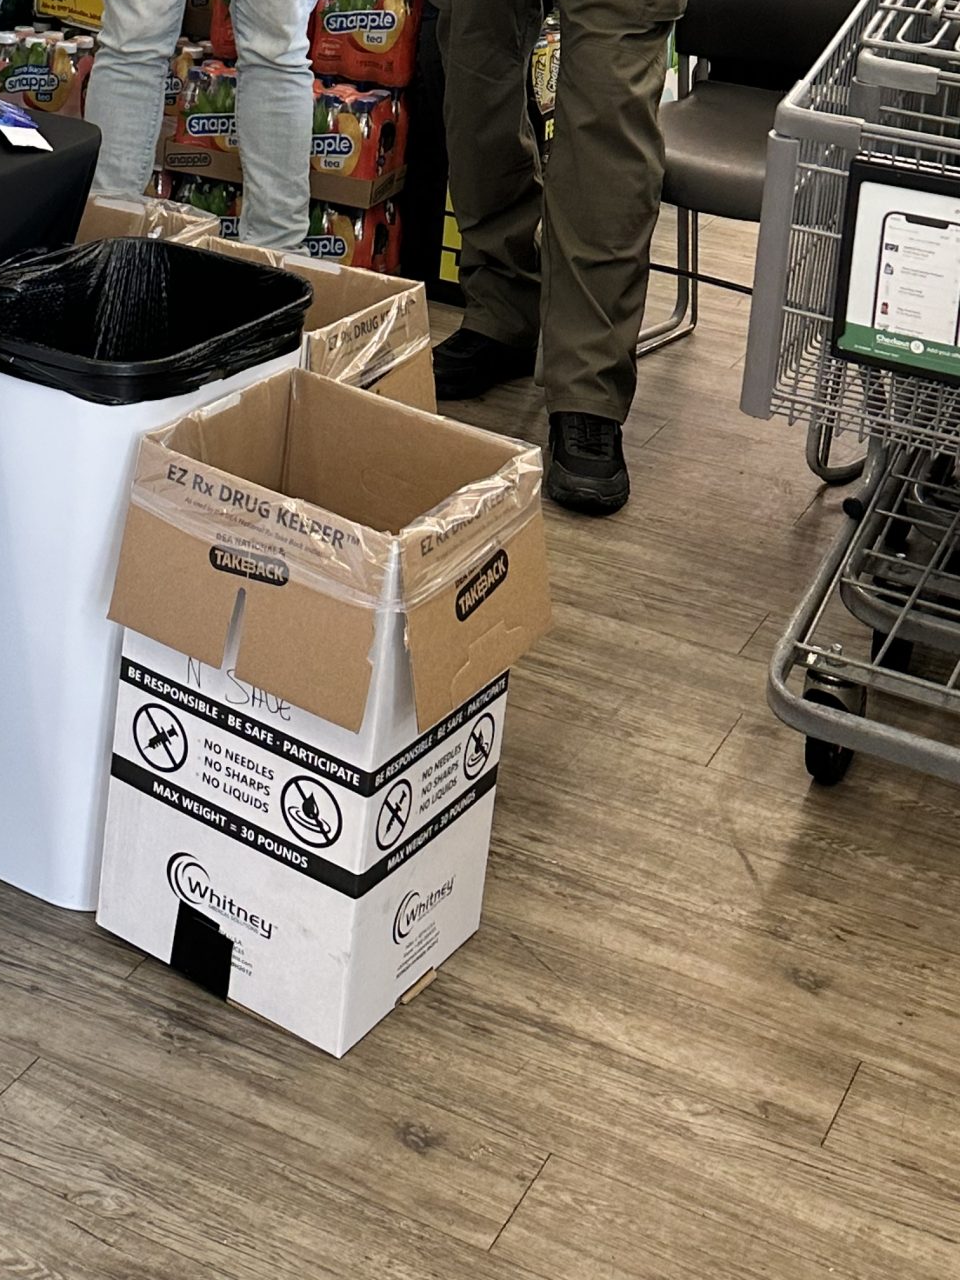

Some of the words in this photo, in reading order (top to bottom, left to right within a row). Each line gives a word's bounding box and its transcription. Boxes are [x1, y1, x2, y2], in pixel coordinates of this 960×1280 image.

[327, 13, 394, 32] snapple
[366, 34, 382, 44] tea
[8, 76, 58, 91] snapple
[168, 154, 209, 167] snapple
[324, 159, 340, 168] tea
[354, 315, 378, 339] DRUG
[167, 464, 188, 487] EZ
[192, 474, 214, 497] Rx
[218, 483, 270, 519] DRUG
[421, 535, 434, 556] EZ
[128, 666, 142, 682] BE
[143, 673, 219, 719] RESPONSIBLE
[227, 714, 242, 731] BE
[244, 723, 274, 745] SAFE
[283, 740, 361, 787] PARTICIPATE
[375, 773, 385, 787] BE
[385, 733, 434, 783] RESPONSIBLE
[437, 726, 446, 741] BE
[446, 711, 464, 735] SAFE
[467, 677, 507, 716] PARTICIPATE
[204, 738, 222, 755] NO
[224, 748, 275, 781] NEEDLES
[204, 755, 222, 773] NO
[225, 765, 271, 797] SHARPS
[421, 768, 433, 782] NO
[434, 742, 462, 770] NEEDLES
[421, 784, 432, 798] NO
[432, 760, 459, 786] SHARPS
[202, 772, 220, 789] NO
[223, 781, 270, 814] LIQUIDS
[419, 801, 430, 815] NO
[431, 775, 458, 804] LIQUIDS
[152, 781, 180, 804] MAX
[182, 792, 227, 827] WEIGHT
[241, 826, 255, 841] 30
[257, 835, 309, 868] POUNDS
[387, 851, 405, 870] MAX
[405, 825, 434, 856] WEIGHT
[439, 814, 448, 828] 30
[448, 789, 476, 822] POUNDS
[188, 876, 272, 939] Whitney
[405, 877, 455, 927] Whitney
